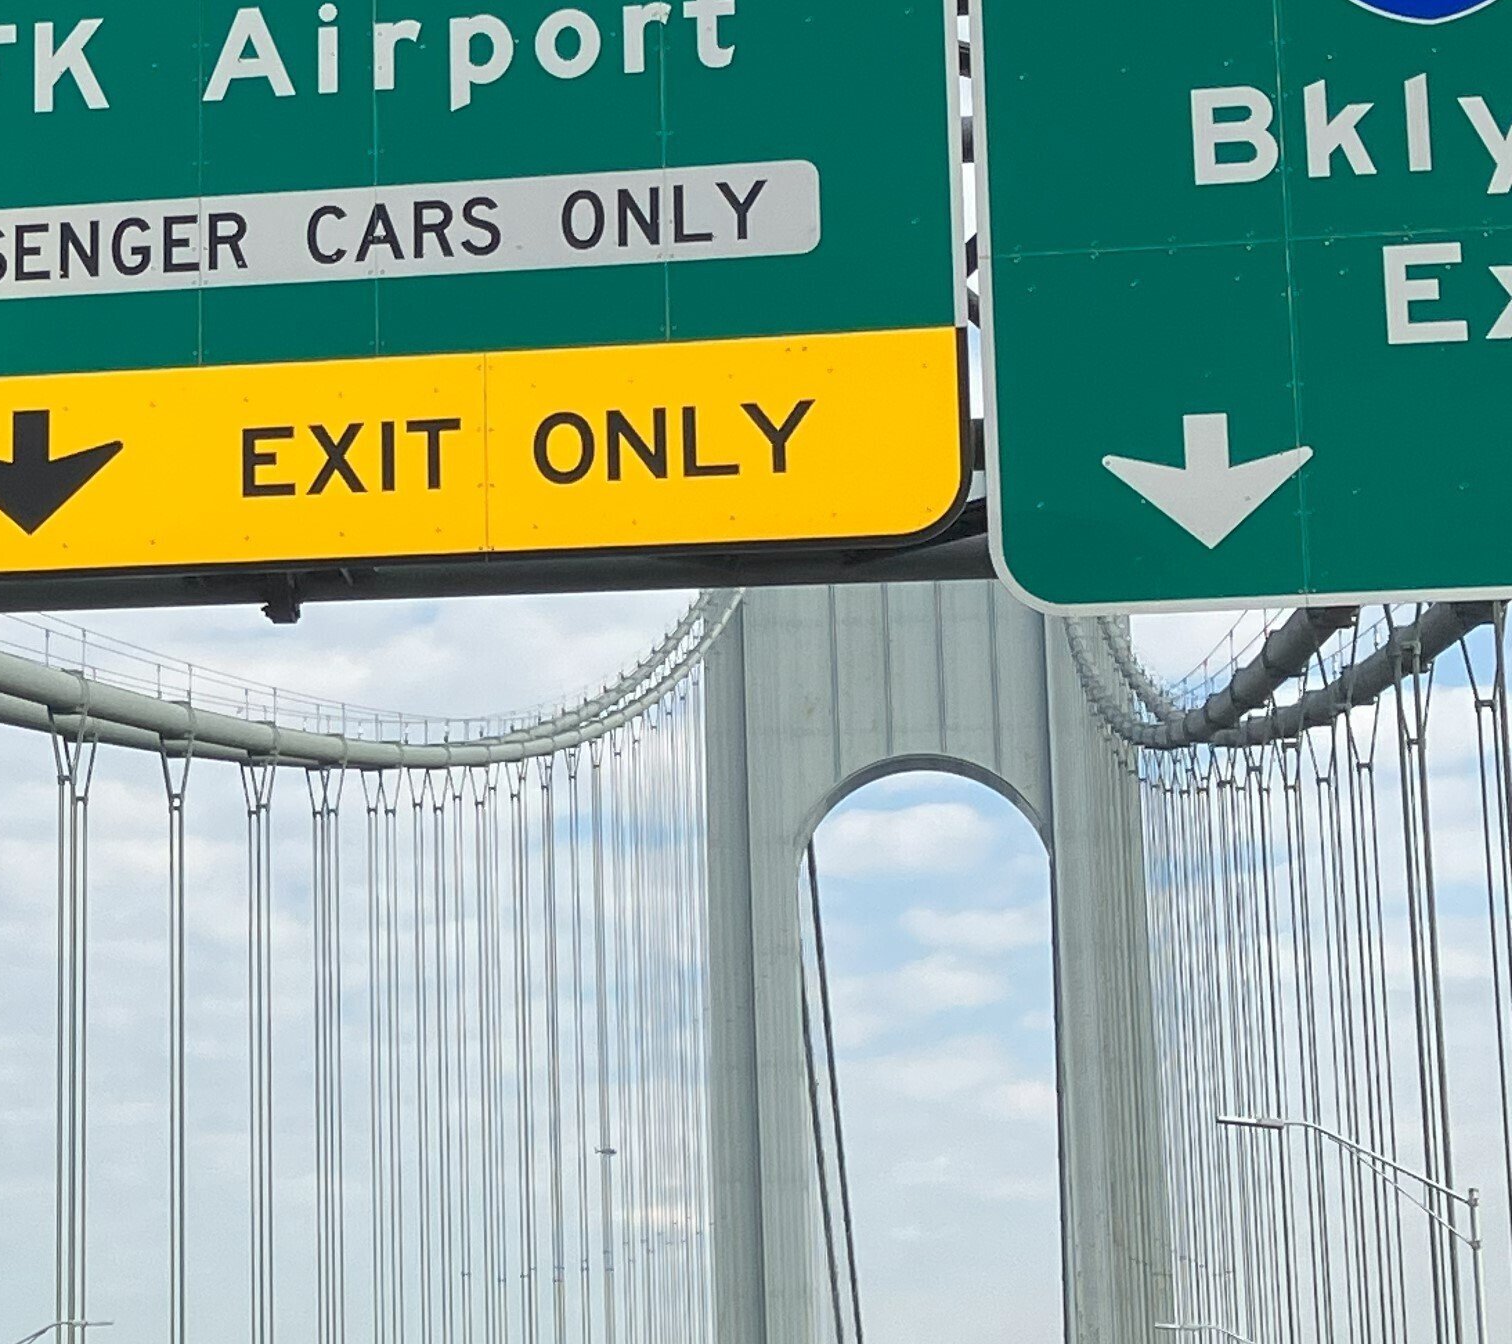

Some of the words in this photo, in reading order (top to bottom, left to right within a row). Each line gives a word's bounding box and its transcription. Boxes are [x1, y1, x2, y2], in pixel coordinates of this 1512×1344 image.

[307, 197, 501, 264] CARS
[562, 180, 768, 249] ONLY
[242, 417, 461, 498] EXIT
[532, 400, 814, 484] ONLY
